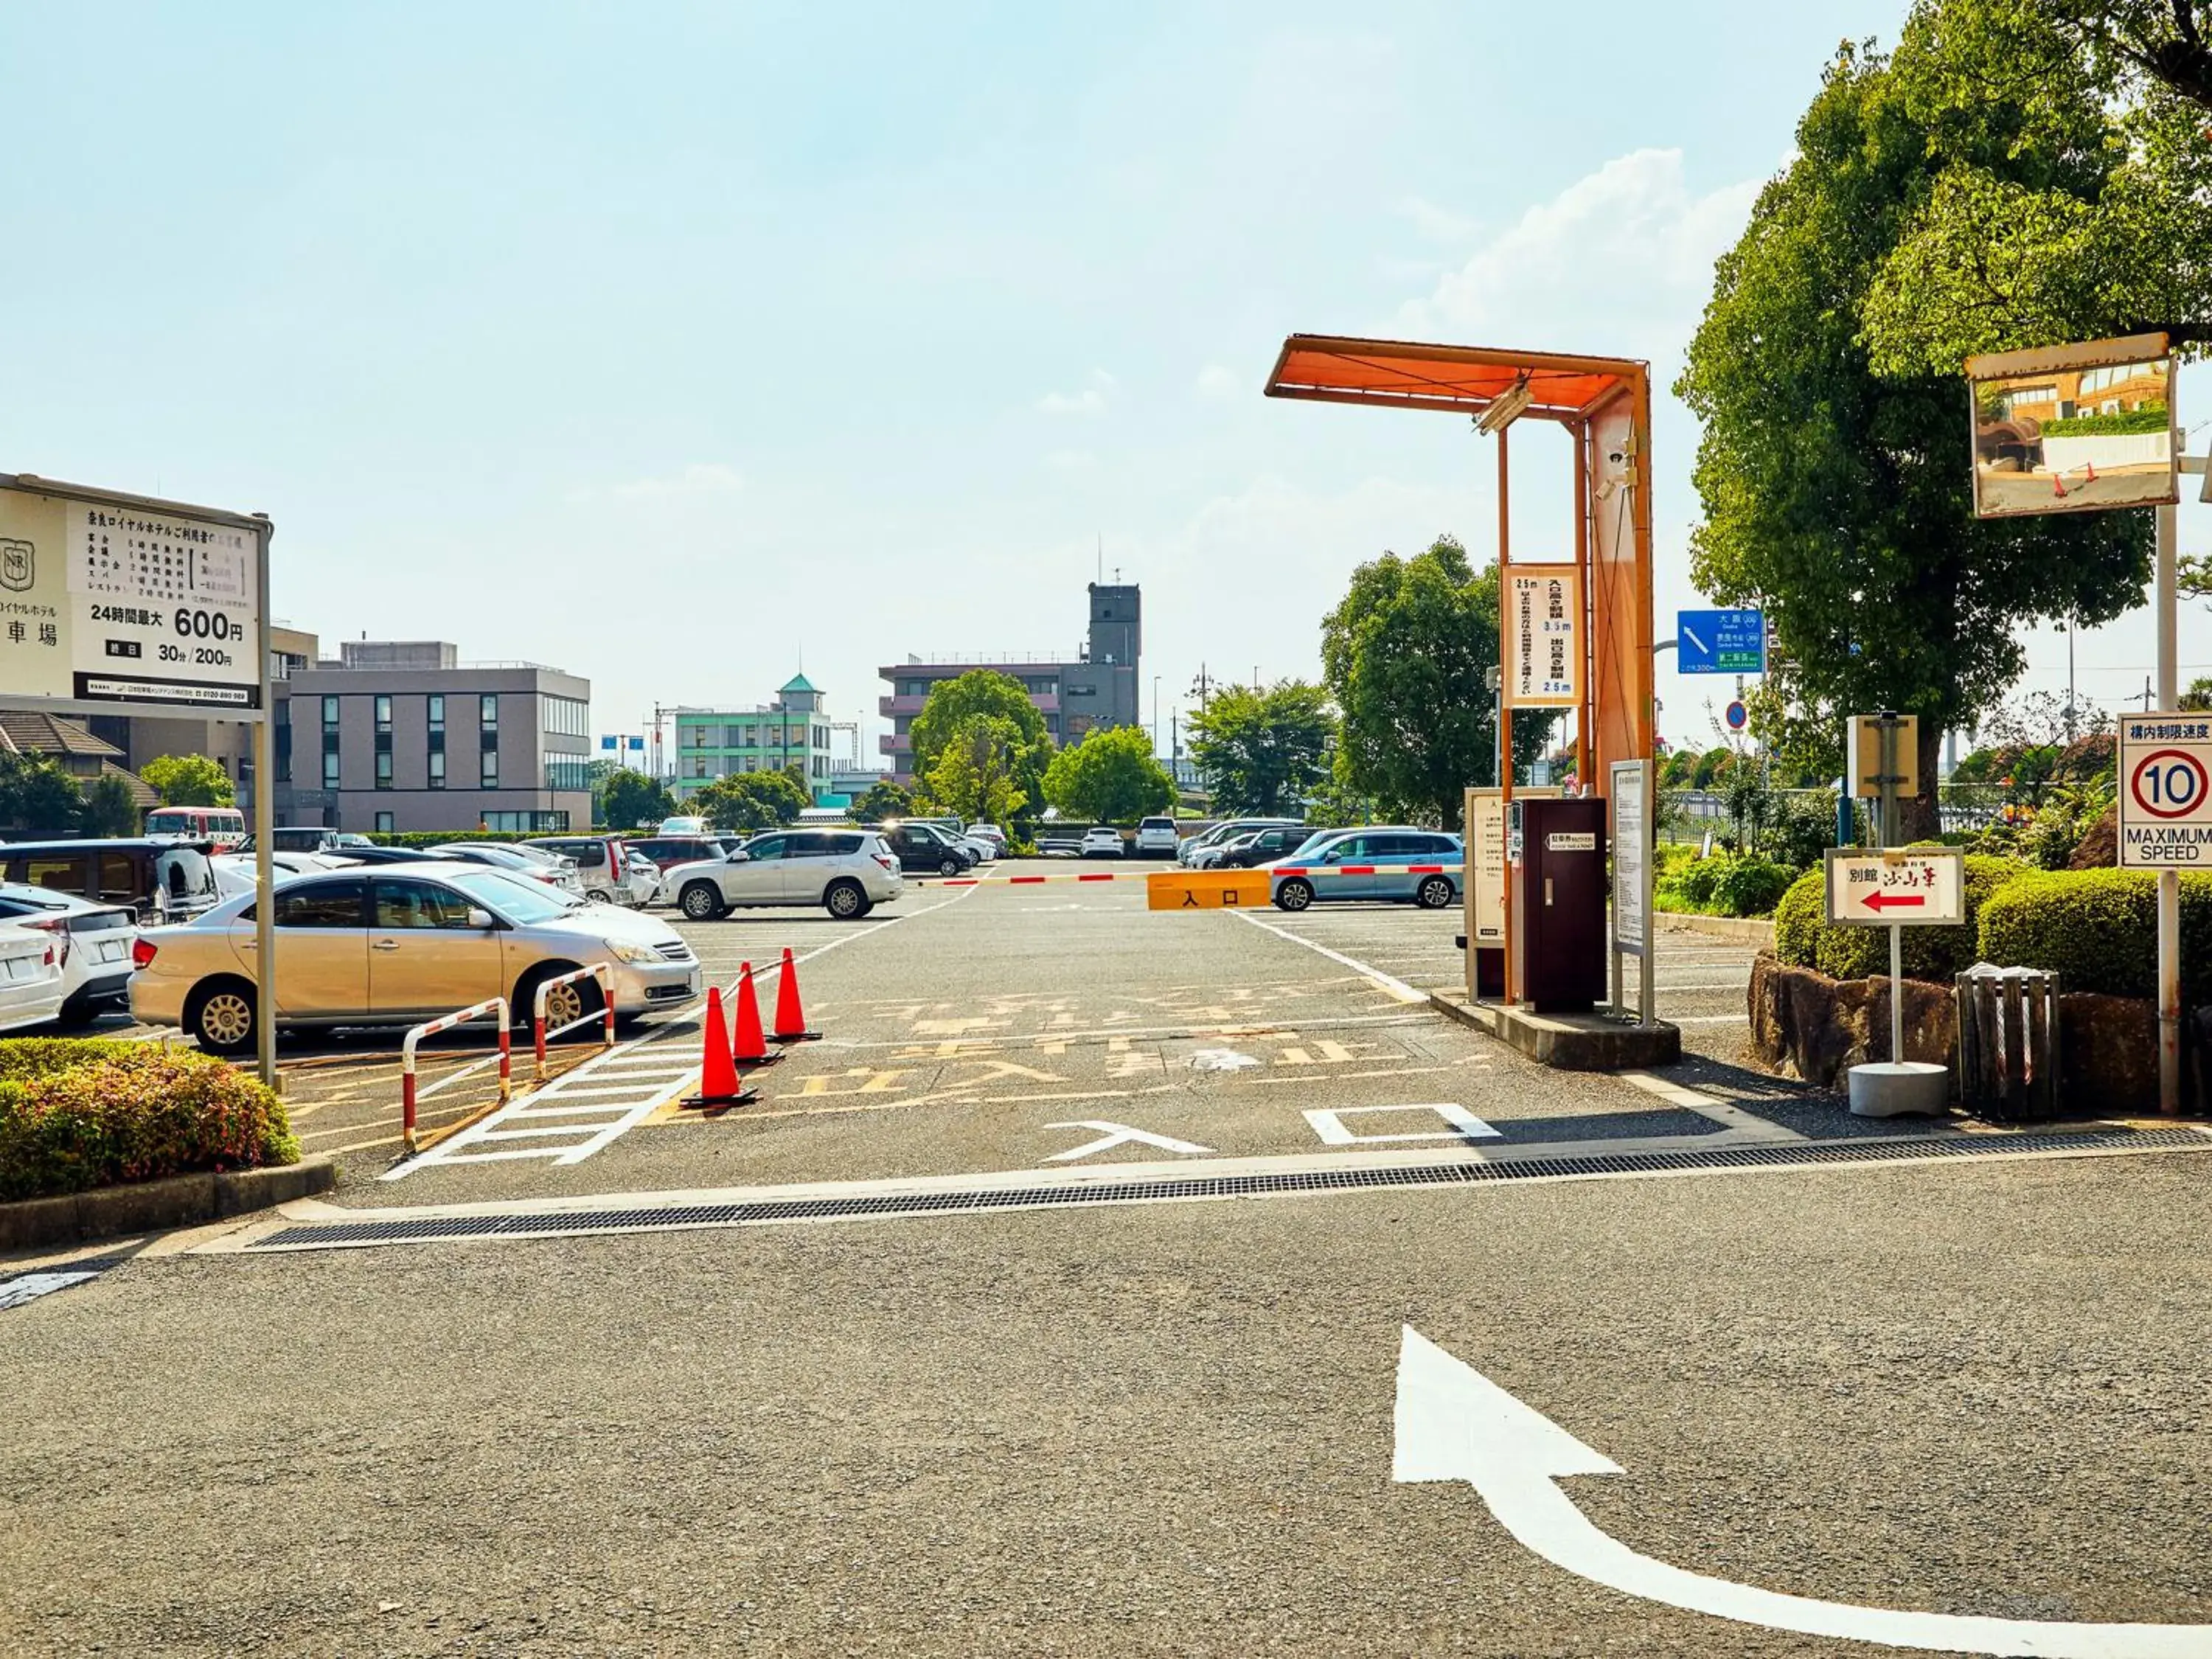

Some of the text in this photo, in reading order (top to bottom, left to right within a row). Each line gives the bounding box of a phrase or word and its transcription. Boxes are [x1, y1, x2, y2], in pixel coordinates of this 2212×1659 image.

[7, 554, 24, 568] NR
[90, 604, 243, 641] 24時間最大 600円
[2130, 724, 2210, 740] 構内制限速度
[2145, 765, 2195, 804] 10
[2127, 828, 2212, 844] MAXIMUM
[2140, 845, 2199, 860] SPEED
[1850, 869, 1878, 883] 別館
[1183, 890, 1238, 908] 入口
[1037, 1103, 1504, 1163] 入口
